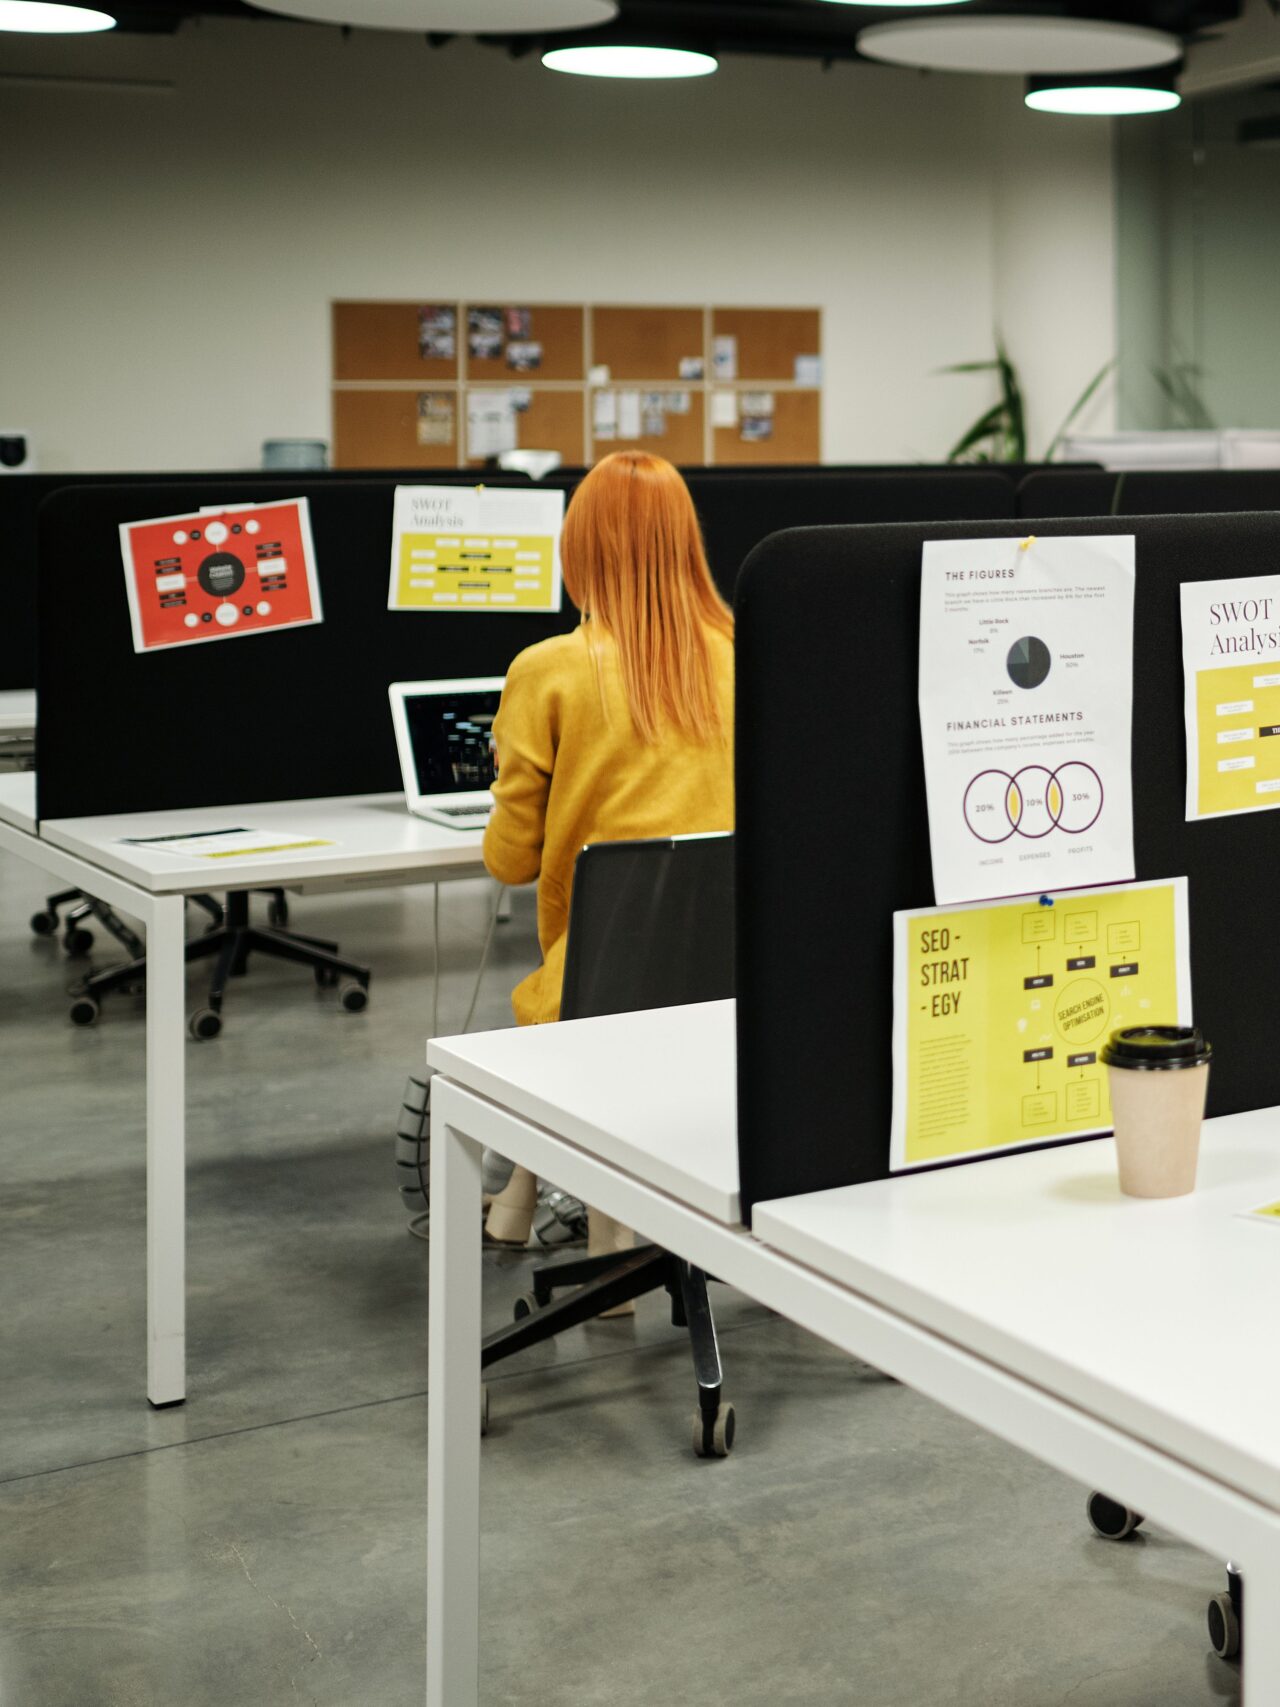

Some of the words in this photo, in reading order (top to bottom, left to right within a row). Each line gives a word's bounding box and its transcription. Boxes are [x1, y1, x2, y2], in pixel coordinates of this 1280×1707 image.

[946, 571, 965, 581] THE
[969, 569, 1015, 579] FIGURES
[1210, 598, 1273, 625] SWOT
[946, 718, 1006, 732] FINANCIAL
[1010, 711, 1083, 726] STATEMENTS
[976, 804, 994, 813] 20%
[1026, 799, 1043, 807] 10%
[1019, 852, 1051, 862] EXPENSES
[1067, 846, 1093, 854] PROFITS
[921, 928, 950, 954] SEO
[921, 957, 970, 986] STRAT
[932, 990, 961, 1017] EGY
[1057, 1003, 1082, 1021] SEARCH
[1082, 993, 1104, 1010] ENGINE
[1062, 1006, 1105, 1031] OPTIMISATION
